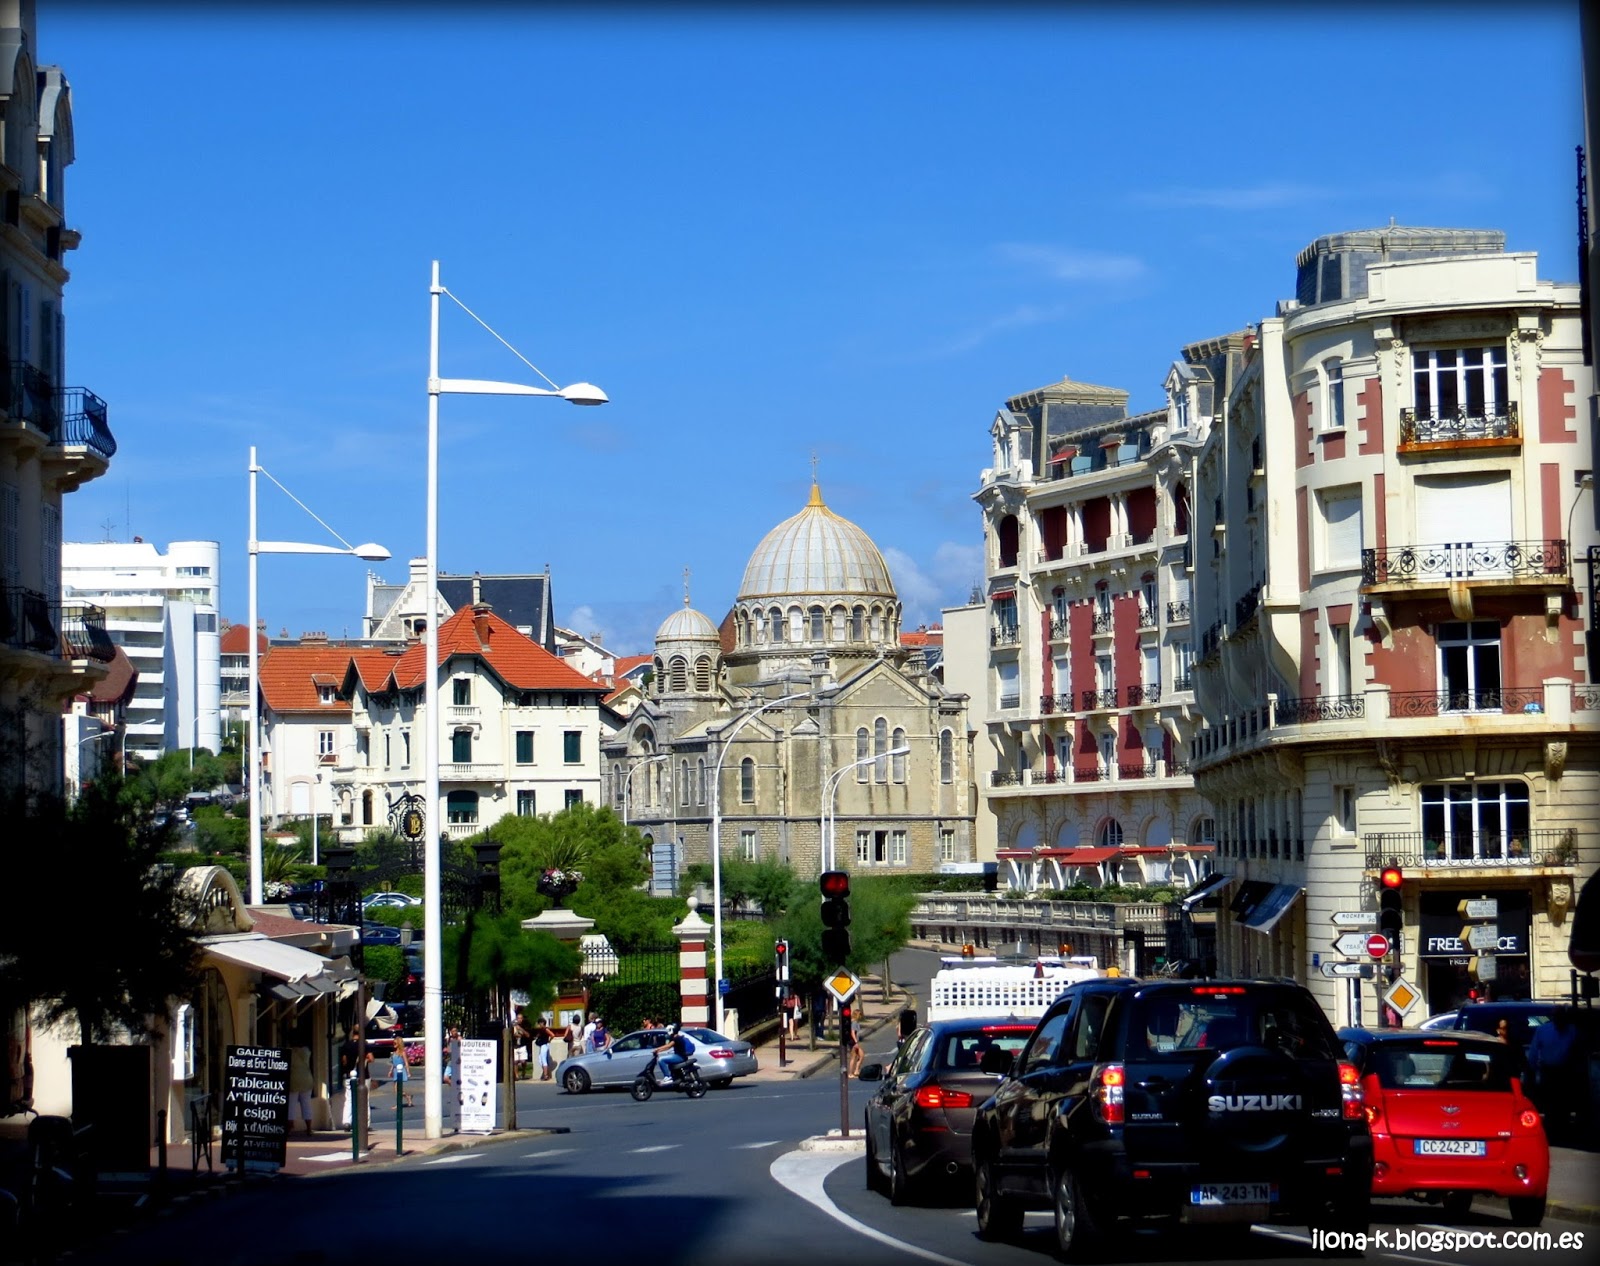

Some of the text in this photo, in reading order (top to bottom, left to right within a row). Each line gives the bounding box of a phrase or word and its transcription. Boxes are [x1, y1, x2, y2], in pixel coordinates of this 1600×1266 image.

[236, 1047, 281, 1058] GALERIE
[228, 1055, 246, 1068] Diane
[247, 1059, 254, 1069] et
[267, 1058, 288, 1071] Lhoste
[229, 1076, 285, 1091] Tableaux
[1208, 1095, 1303, 1112] SUZUKI
[227, 1138, 281, 1149] ACAT-VENTE
